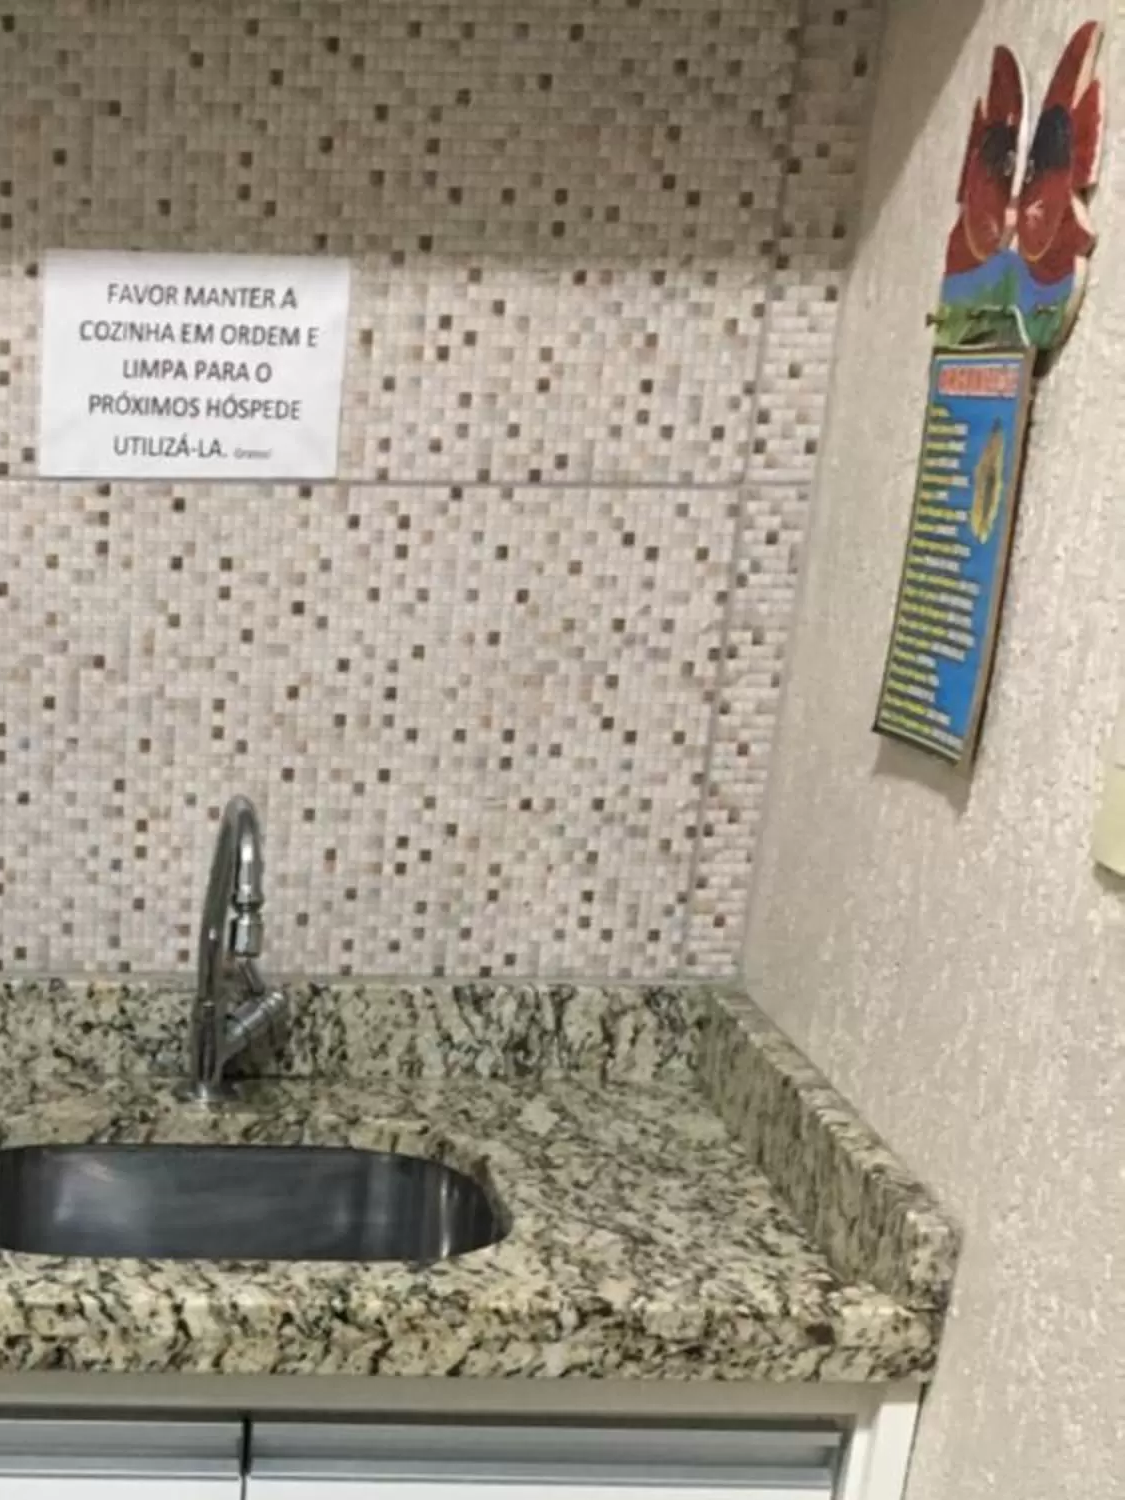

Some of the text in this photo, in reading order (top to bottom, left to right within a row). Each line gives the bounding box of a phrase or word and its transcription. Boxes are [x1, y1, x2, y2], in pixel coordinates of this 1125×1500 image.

[107, 283, 298, 309] FAVOR MANTER A
[79, 320, 320, 347] COZINHA EM ORDEM E
[122, 359, 273, 384] LIMPA PARA O
[88, 390, 302, 420] PRÓXIMOS HÓSPEDE
[113, 432, 228, 459] UTILIZÁ-LA.
